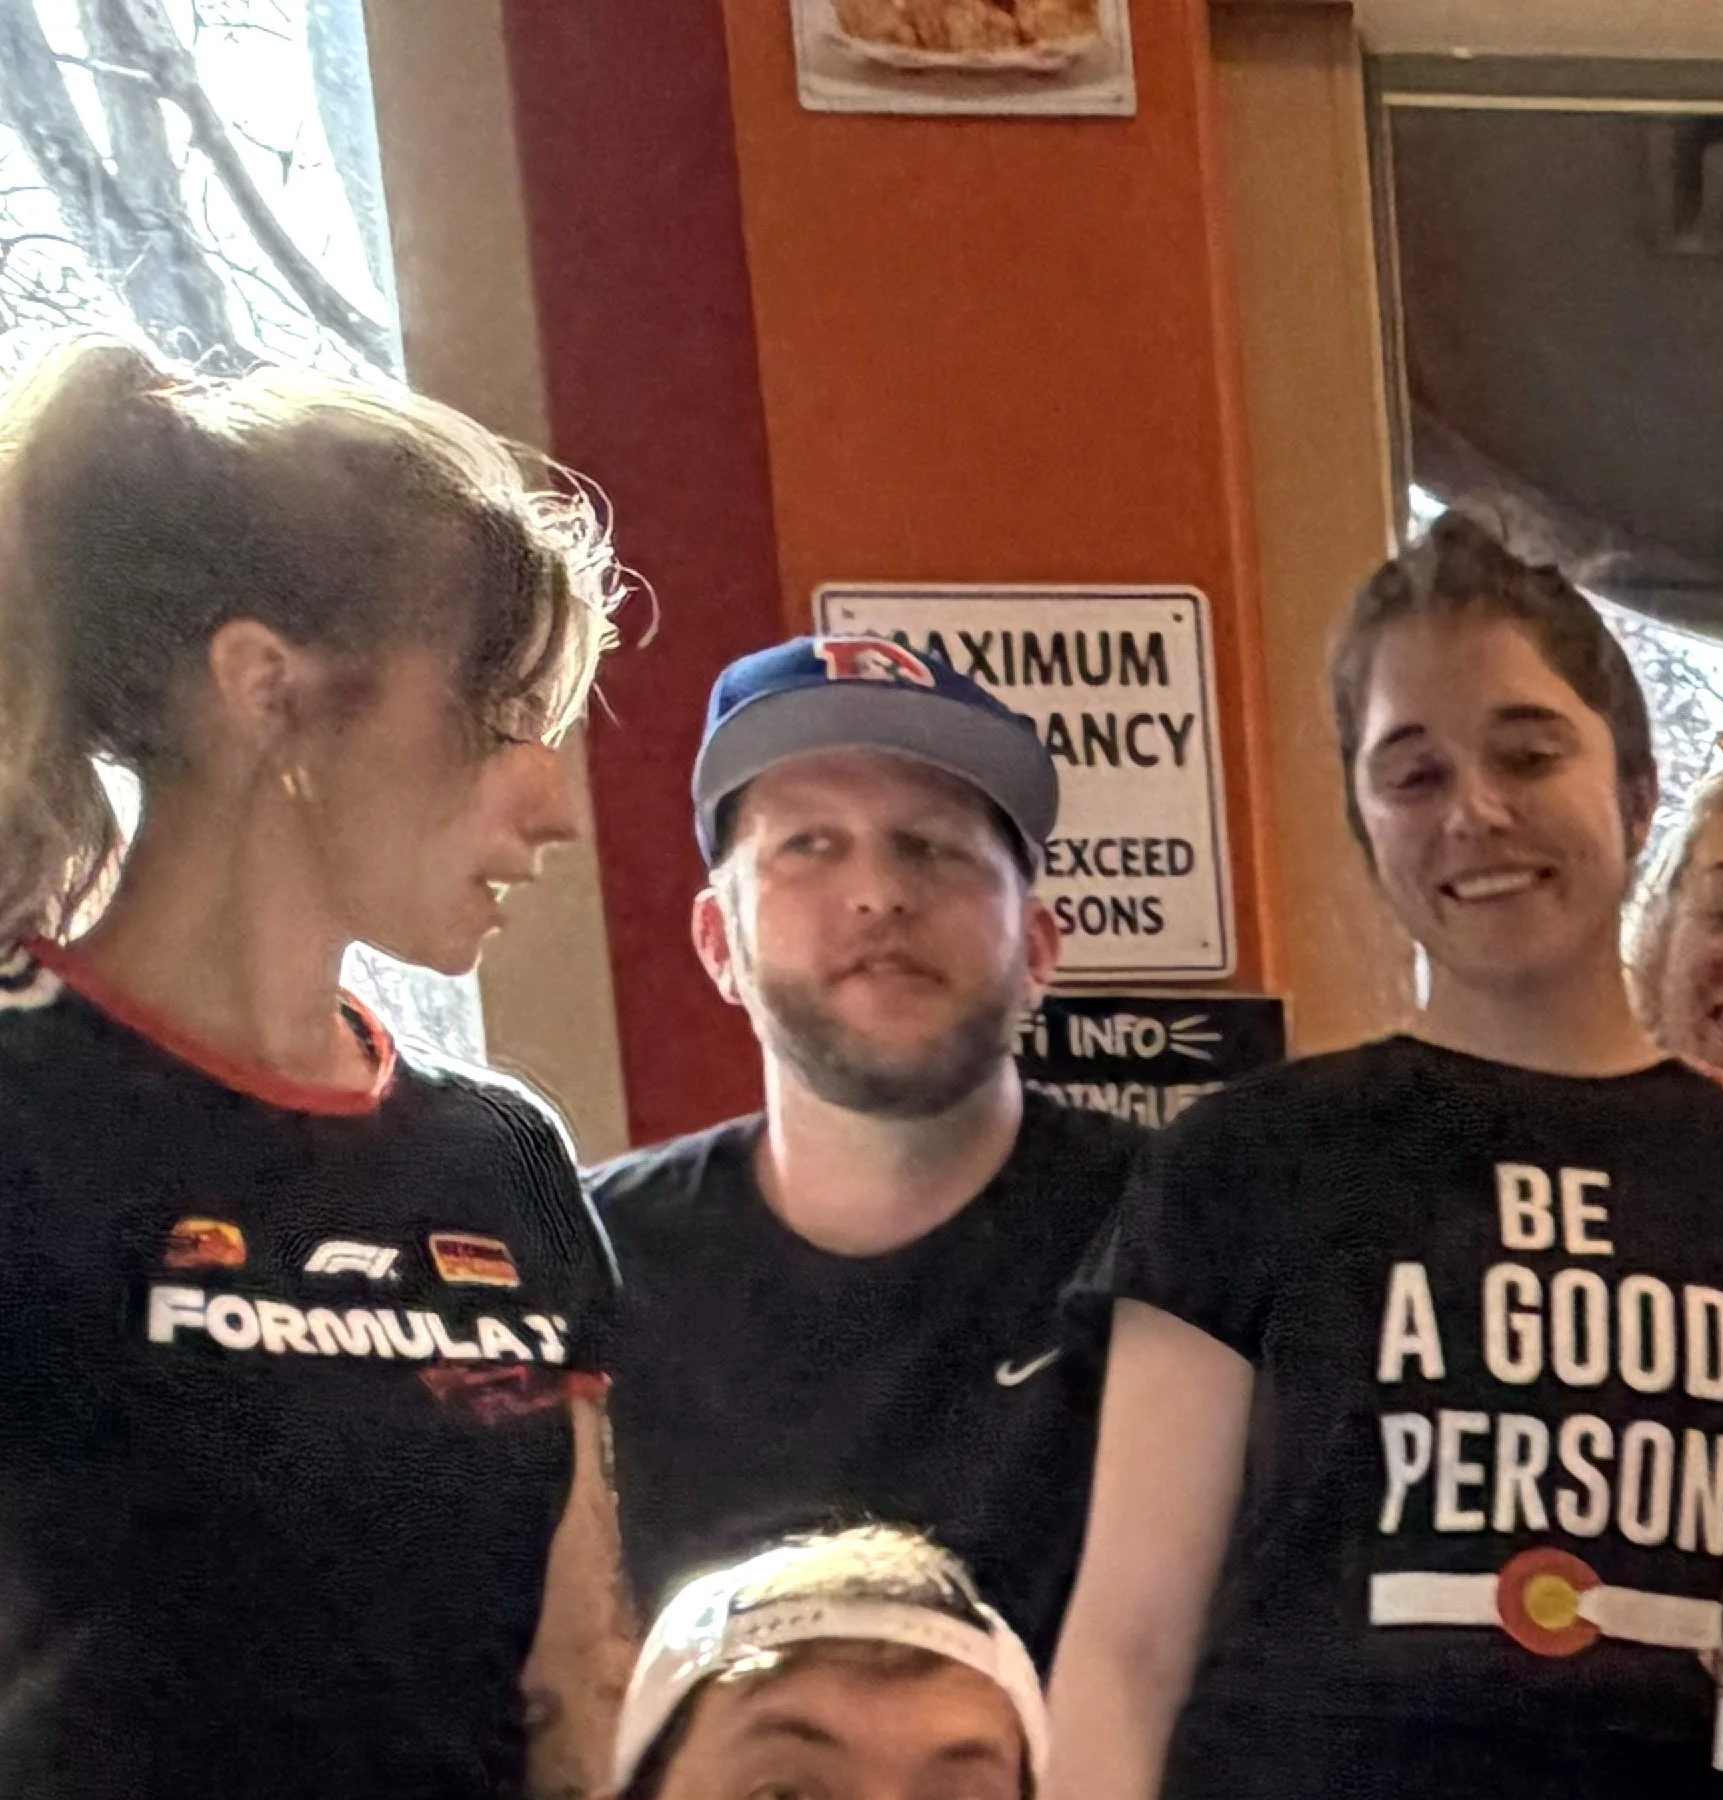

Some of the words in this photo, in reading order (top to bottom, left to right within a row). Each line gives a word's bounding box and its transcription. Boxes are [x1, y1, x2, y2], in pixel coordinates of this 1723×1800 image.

[1046, 712, 1195, 767] ANCY
[1045, 838, 1195, 877] EXCEED
[1054, 895, 1165, 936] SONS
[1067, 1013, 1166, 1059] INFO
[1495, 1162, 1615, 1256] BE
[147, 1285, 532, 1361] FORMULA
[1376, 1262, 1446, 1384] A
